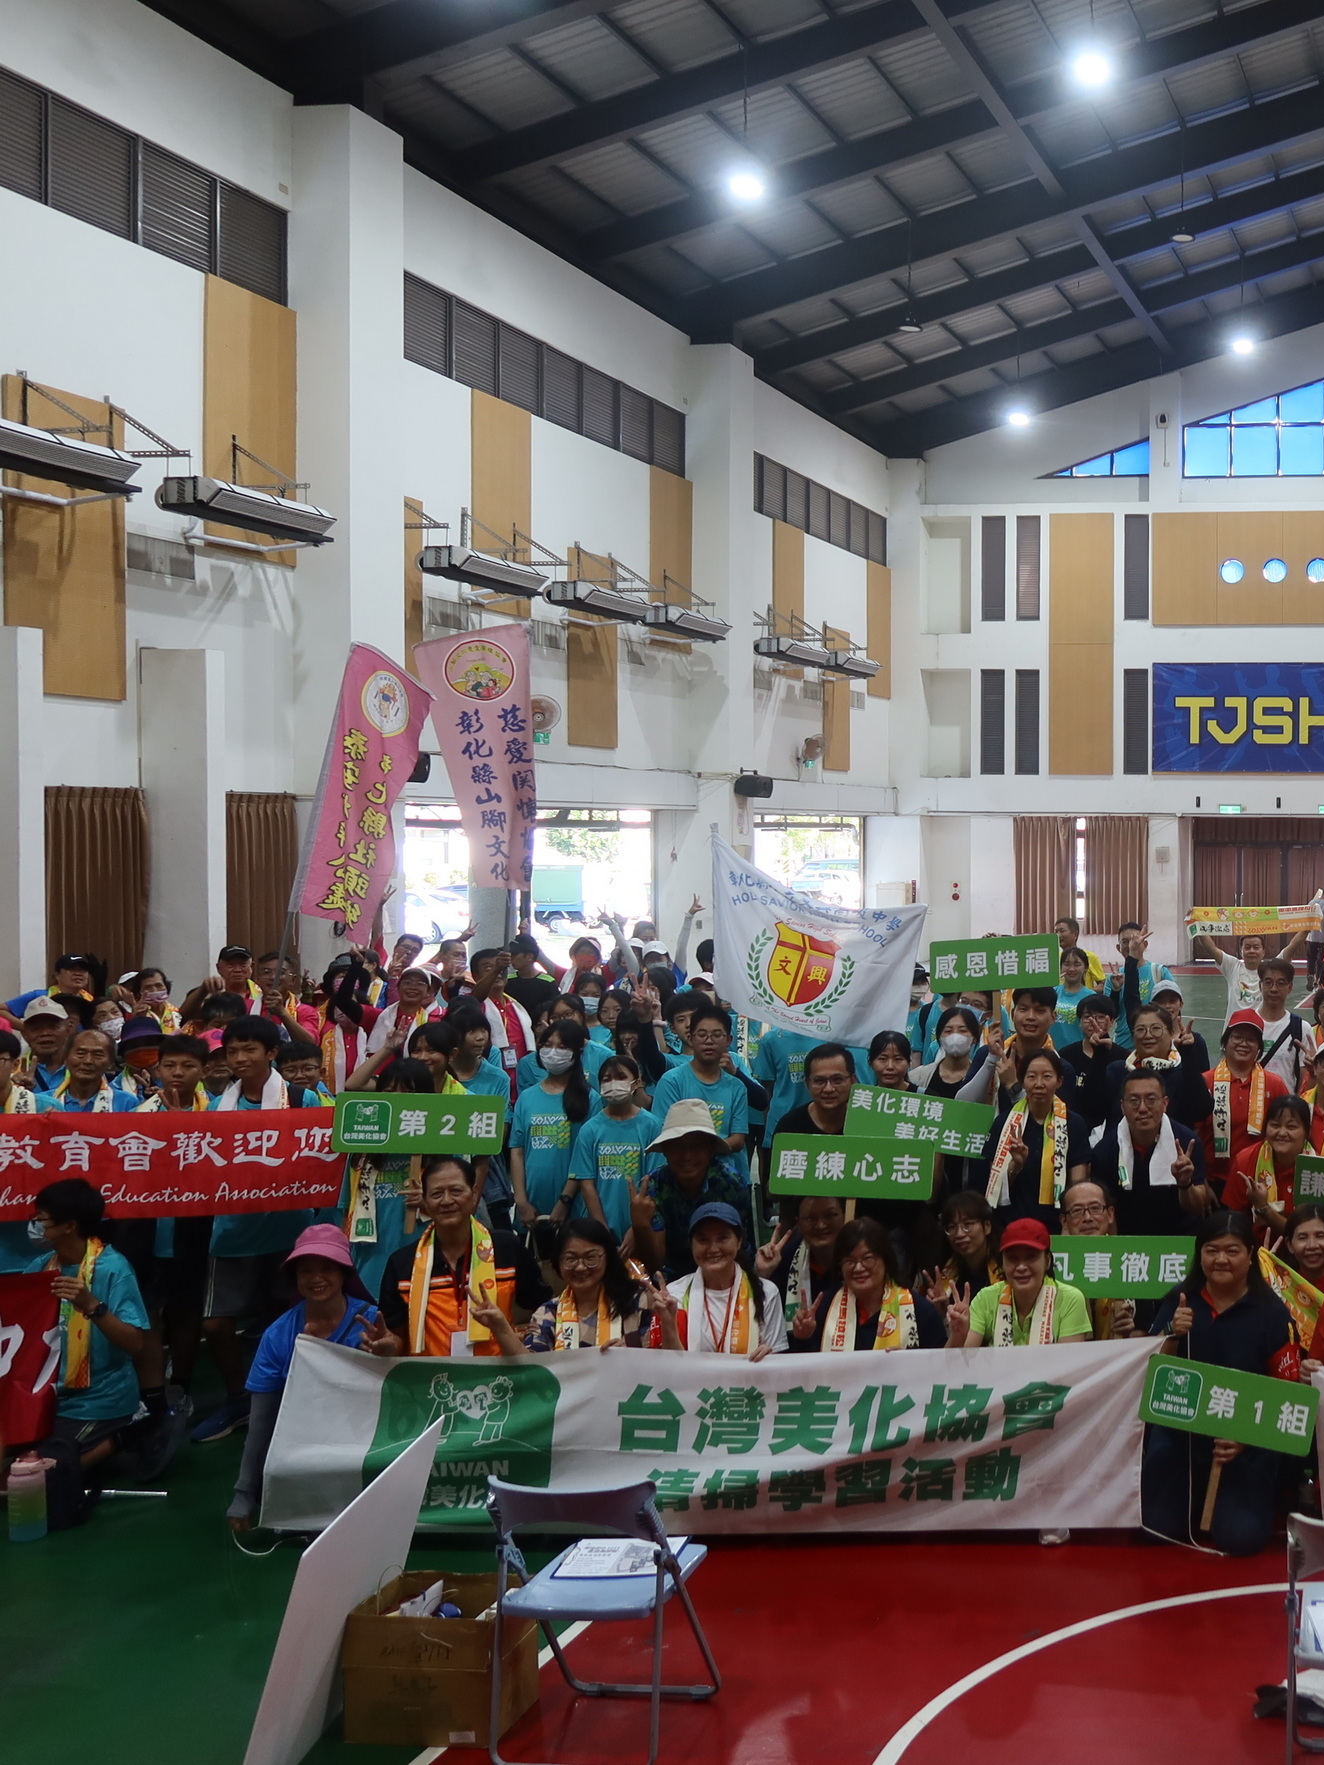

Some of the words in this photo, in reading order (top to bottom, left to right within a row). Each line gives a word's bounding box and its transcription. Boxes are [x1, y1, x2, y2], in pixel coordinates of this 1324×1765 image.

[773, 956, 792, 976] 文
[807, 965, 827, 985] 興
[934, 947, 1050, 980] 感恩惜福
[852, 1088, 945, 1122] 美化環境
[895, 1121, 986, 1154] 美好生活
[776, 1149, 921, 1184] 磨練心志
[100, 1183, 209, 1205] Education
[214, 1180, 337, 1206] Association
[1052, 1252, 1188, 1283] 凡事徹底
[617, 1381, 1072, 1455] 台灣美化協會
[429, 1459, 510, 1478] AIWAN
[647, 1445, 1022, 1513] 清掃學習活動
